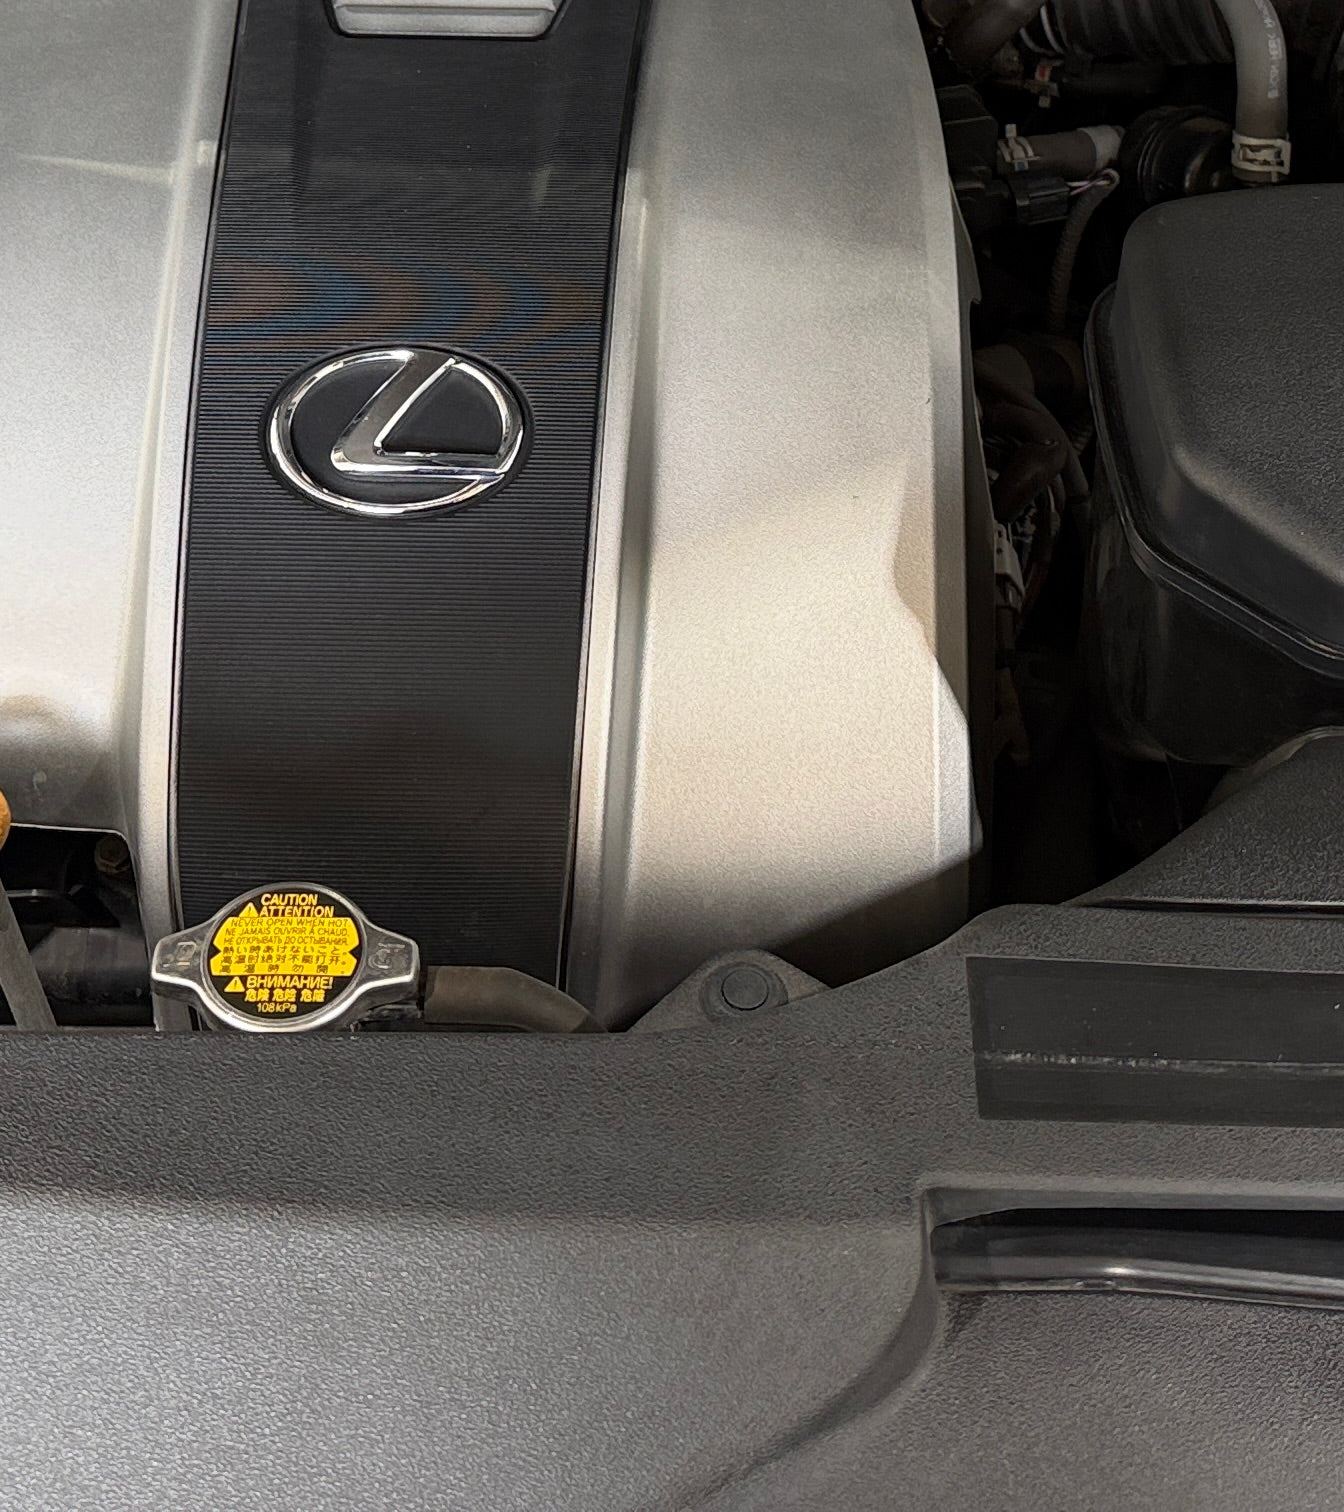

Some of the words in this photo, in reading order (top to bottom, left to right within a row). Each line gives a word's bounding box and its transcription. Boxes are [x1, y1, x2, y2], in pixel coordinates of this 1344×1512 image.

[261, 893, 318, 906] CAUTION
[260, 906, 335, 917] ATTENTION
[231, 919, 264, 927] NEVER
[266, 918, 292, 926] OPEN
[239, 927, 271, 935] JAMAIS
[247, 976, 333, 989] ВНИМАНИЕ!
